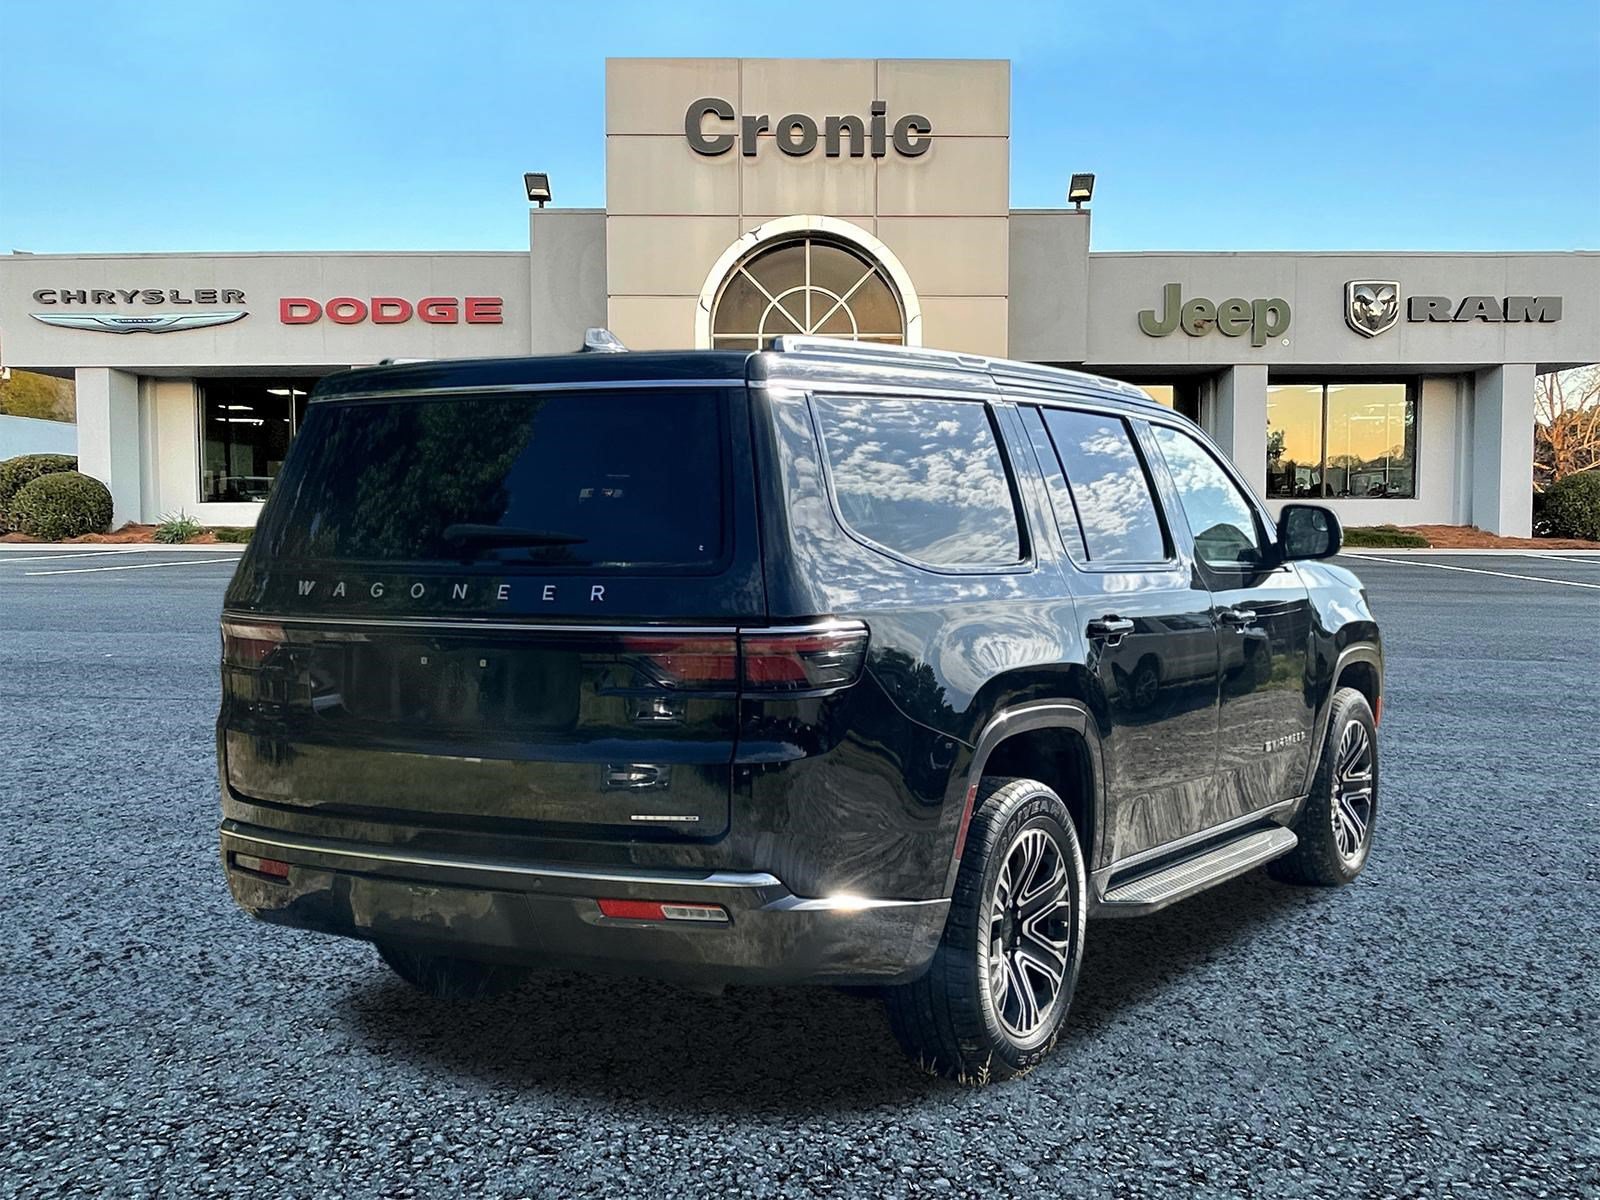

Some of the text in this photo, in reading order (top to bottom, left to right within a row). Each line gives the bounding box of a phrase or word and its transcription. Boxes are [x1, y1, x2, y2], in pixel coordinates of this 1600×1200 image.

[685, 97, 932, 157] Cronic
[32, 287, 247, 306] CHRYSLER
[279, 296, 504, 325] DODGE
[1407, 295, 1563, 323] RAM
[1138, 283, 1291, 347] Jeep
[297, 579, 606, 602] WAGONEER
